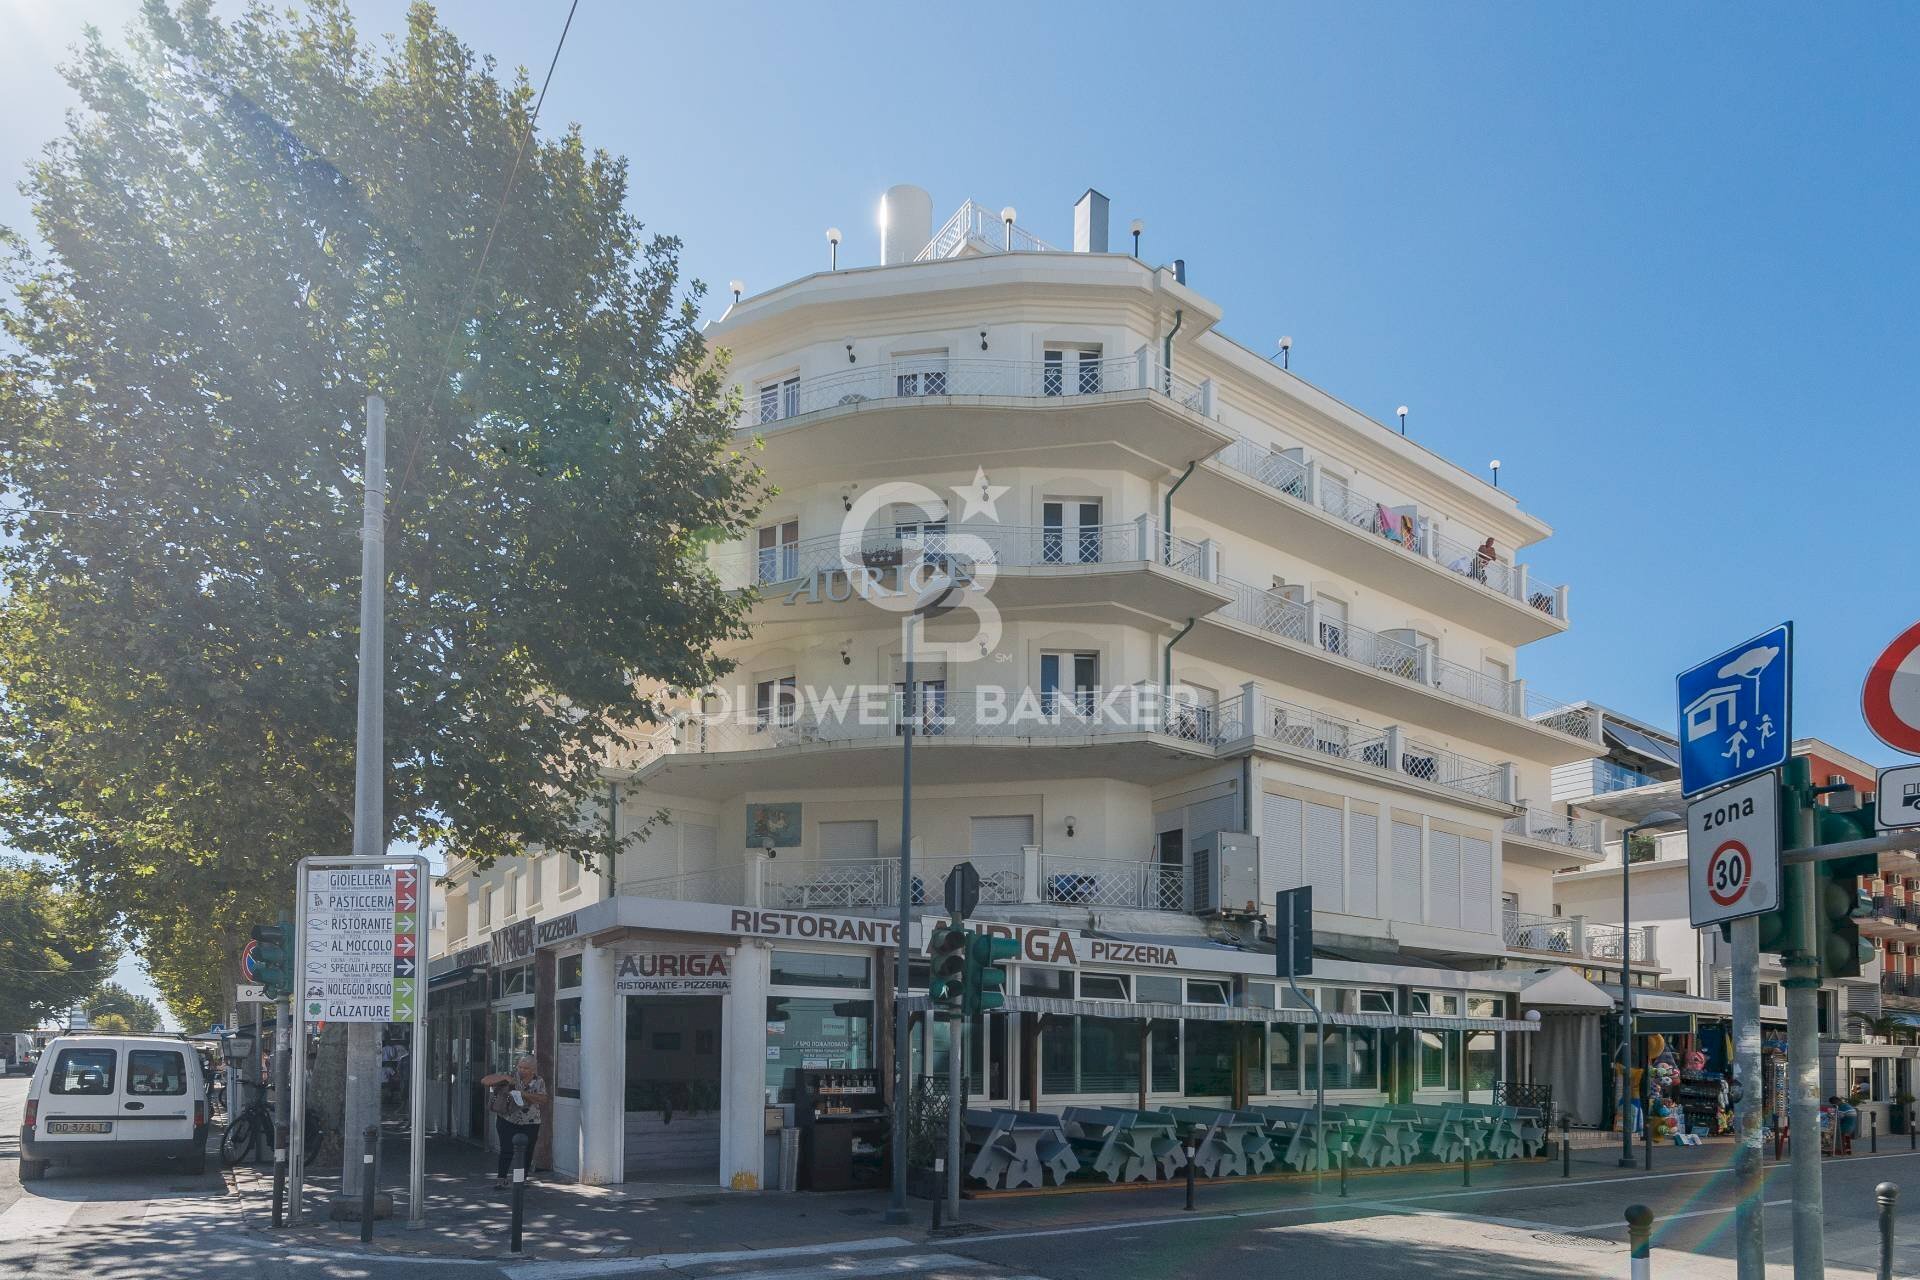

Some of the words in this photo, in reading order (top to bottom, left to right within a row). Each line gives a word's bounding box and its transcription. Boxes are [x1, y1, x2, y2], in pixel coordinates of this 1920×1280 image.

[1703, 797, 1754, 831] zona
[1716, 855, 1742, 890] 30
[330, 874, 392, 886] GIOIELLERIA
[329, 896, 394, 908] PASTICCERIA
[331, 918, 392, 930] RISTORANTE
[537, 913, 578, 944] PIZZERIA
[731, 909, 901, 944] RISTORANTE
[1091, 941, 1178, 965] PIZZERIA
[331, 940, 343, 951] AL
[346, 940, 392, 952] MOCCOLO
[371, 963, 392, 973] PESCE
[618, 954, 728, 977] AURIGA
[327, 983, 365, 995] NOLEGGIO
[616, 981, 677, 990] RISTORANTE
[684, 980, 730, 989] PIZZERIA
[329, 1005, 390, 1017] CALZATURE
